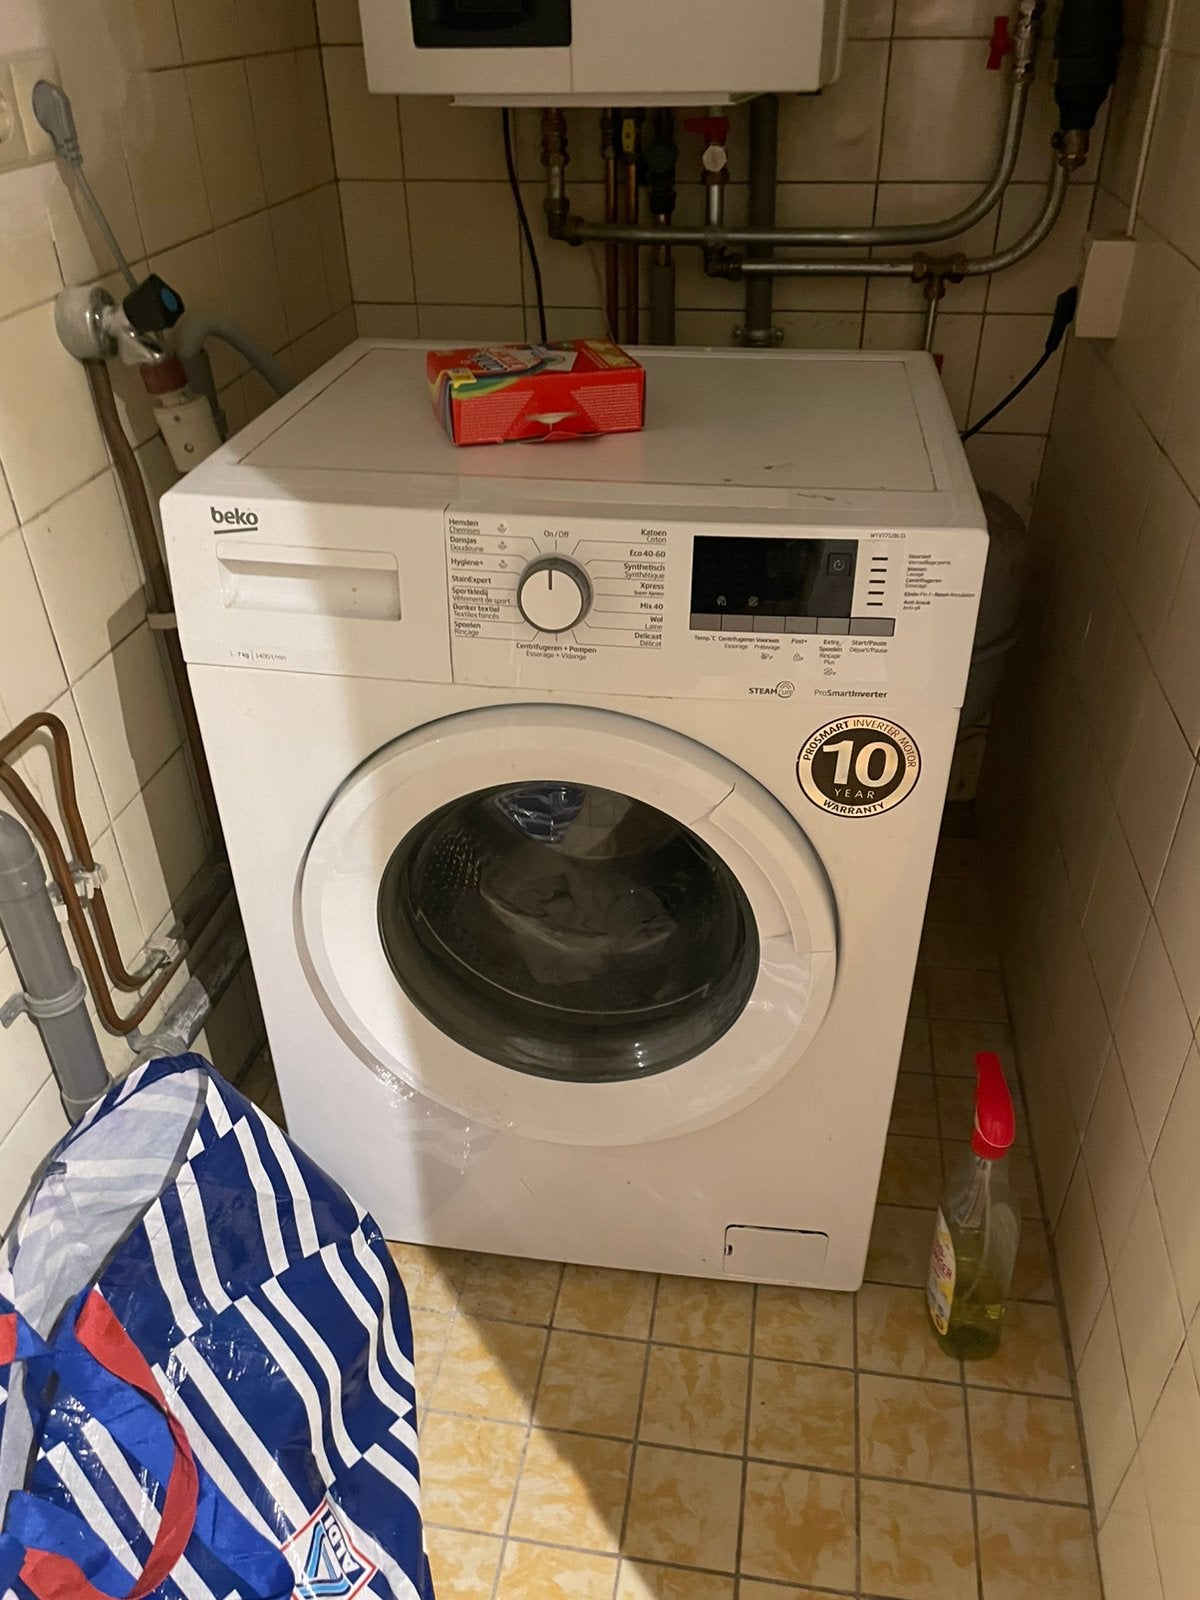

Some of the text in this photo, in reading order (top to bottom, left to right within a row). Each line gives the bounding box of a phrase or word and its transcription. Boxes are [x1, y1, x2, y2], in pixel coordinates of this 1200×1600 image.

[210, 506, 258, 526] beko
[448, 518, 478, 527] Hemden
[449, 526, 480, 535] Chemises
[544, 530, 554, 538] On
[558, 530, 569, 538] Off
[641, 528, 667, 537] Katoen
[450, 536, 477, 544] Donsjas
[646, 536, 667, 544] Coton
[450, 544, 484, 553] Doudoune
[630, 549, 666, 558] Eco 40-60
[624, 562, 665, 572] Synthetisch
[452, 575, 492, 584] StainExpert
[624, 571, 665, 580] Synthétique
[640, 582, 664, 590] Xpress
[452, 587, 488, 597] Sportkledij
[452, 595, 510, 606] Vêtement de sport
[453, 604, 500, 613] Donker textiel
[454, 612, 478, 620] Textiles
[454, 620, 481, 629] Spoelen
[634, 632, 662, 640] Delicaat
[516, 642, 562, 652] Centrifugeren
[569, 646, 597, 654] Pompen
[526, 650, 554, 659] Essorage
[561, 652, 587, 660] Vidange
[748, 686, 778, 696] STEAM
[814, 688, 888, 698] ProSmartInverter
[802, 719, 917, 768] PROSMART INVERTER MOTOR
[822, 740, 899, 788] 10
[834, 788, 876, 799] YEAR
[823, 799, 885, 815] WARRANTY
[324, 1514, 361, 1574] ALDI
